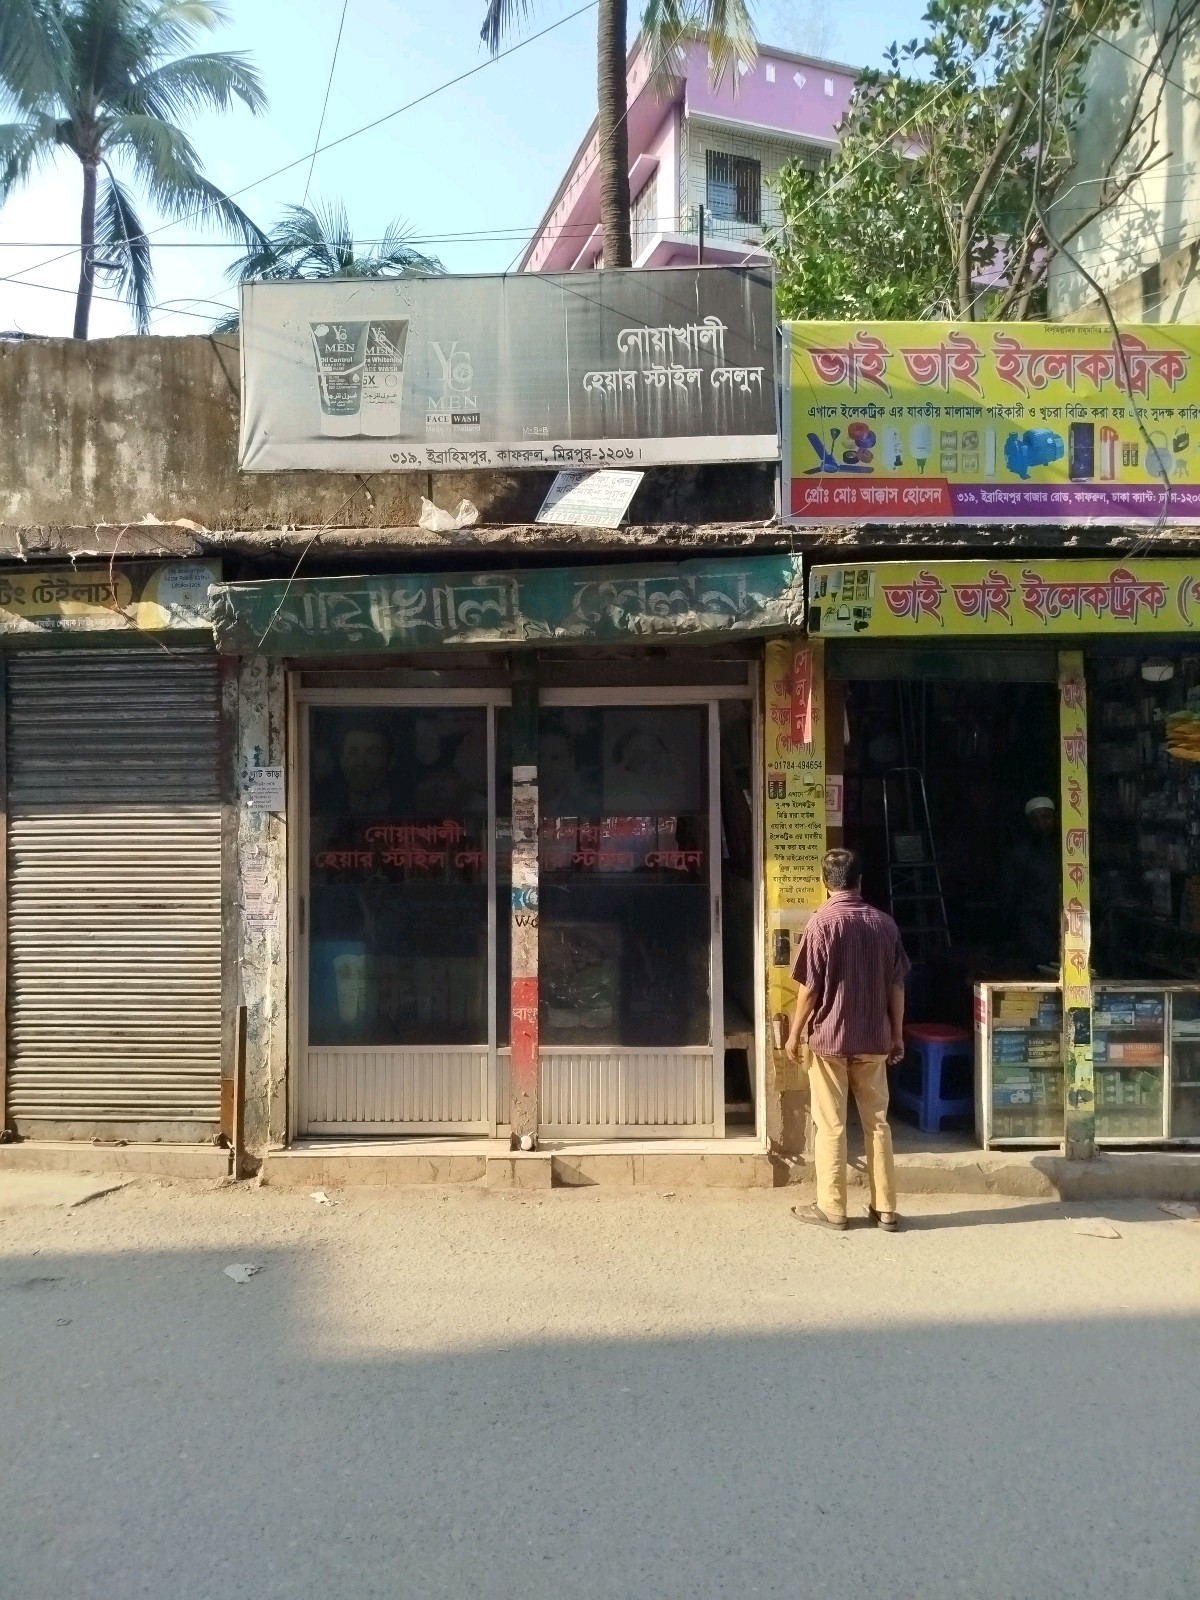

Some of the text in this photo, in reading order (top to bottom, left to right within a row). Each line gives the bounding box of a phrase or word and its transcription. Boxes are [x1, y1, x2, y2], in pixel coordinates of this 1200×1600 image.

[617, 316, 728, 352] নোয়াখালী
[325, 344, 356, 352] MEN
[806, 331, 1191, 400] ভাই ভাই ইলেকট্রিক
[583, 363, 764, 394] হেয়ার স্টাইল সেলুন
[427, 395, 479, 409] MEN
[808, 405, 837, 418] এখানে
[840, 402, 885, 418] ইলেকট্রিক
[889, 405, 903, 418] এর
[907, 402, 941, 418] যাবতীয়
[945, 405, 982, 418] মালামাল
[987, 402, 1025, 419] পাইকারী
[1028, 407, 1036, 417] ও
[1040, 406, 1061, 420] খুচরা
[1065, 403, 1087, 419] বিক্রি
[1091, 406, 1108, 418] করা
[1112, 407, 1124, 418] হয়
[1151, 407, 1174, 421] সুদক্ষ
[1177, 404, 1200, 419] কারি
[453, 415, 478, 423] WASH
[390, 453, 422, 465] ৩১৯,
[426, 448, 492, 465] ইব্রাহিমপুর,
[496, 449, 548, 464] কাফরুল,
[805, 486, 942, 505] প্রোঃ মোঃ আক্কাস হোসেন
[957, 492, 978, 504] ৩১৯,
[980, 489, 1020, 504] ইব্রাহিমপুর
[1024, 491, 1047, 502] বাজার
[1051, 491, 1072, 504] রোড,
[1112, 491, 1130, 502] ঢাকা
[881, 570, 946, 626] ভাই
[951, 570, 1016, 626] ভাই
[1020, 568, 1168, 626] ইলেকট্রিক
[775, 761, 822, 770] 01784-494654
[365, 820, 464, 844] নোয়াখালী
[316, 850, 374, 868] হেয়ার
[382, 848, 447, 869] স্টাইল
[645, 850, 702, 872] সেলুন
